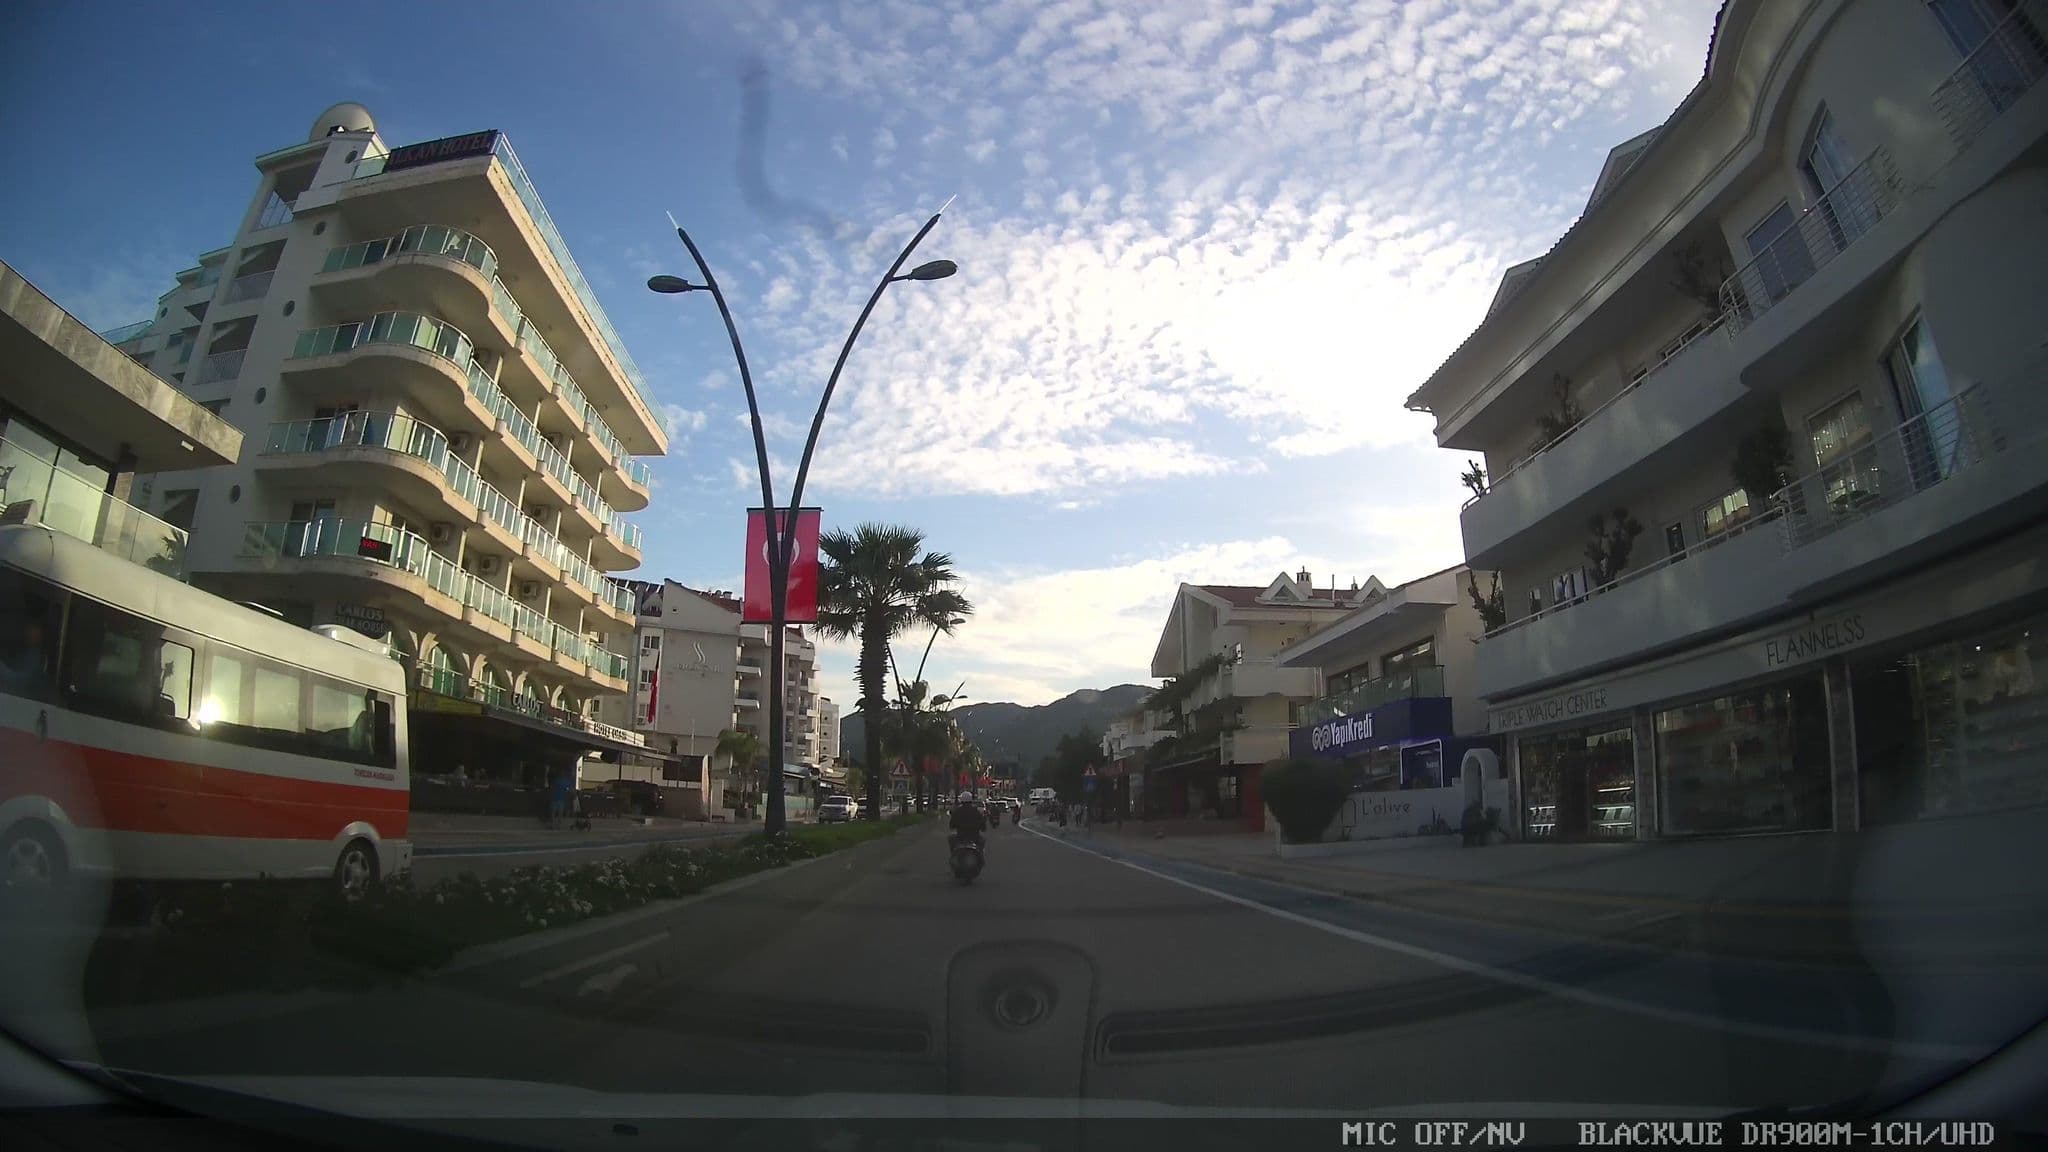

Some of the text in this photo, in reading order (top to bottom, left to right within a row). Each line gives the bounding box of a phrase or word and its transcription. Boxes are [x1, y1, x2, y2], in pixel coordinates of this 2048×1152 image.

[1766, 614, 1865, 667] FLANNELSS
[1526, 695, 1565, 723] WATCH
[1567, 686, 1608, 715] CENTER
